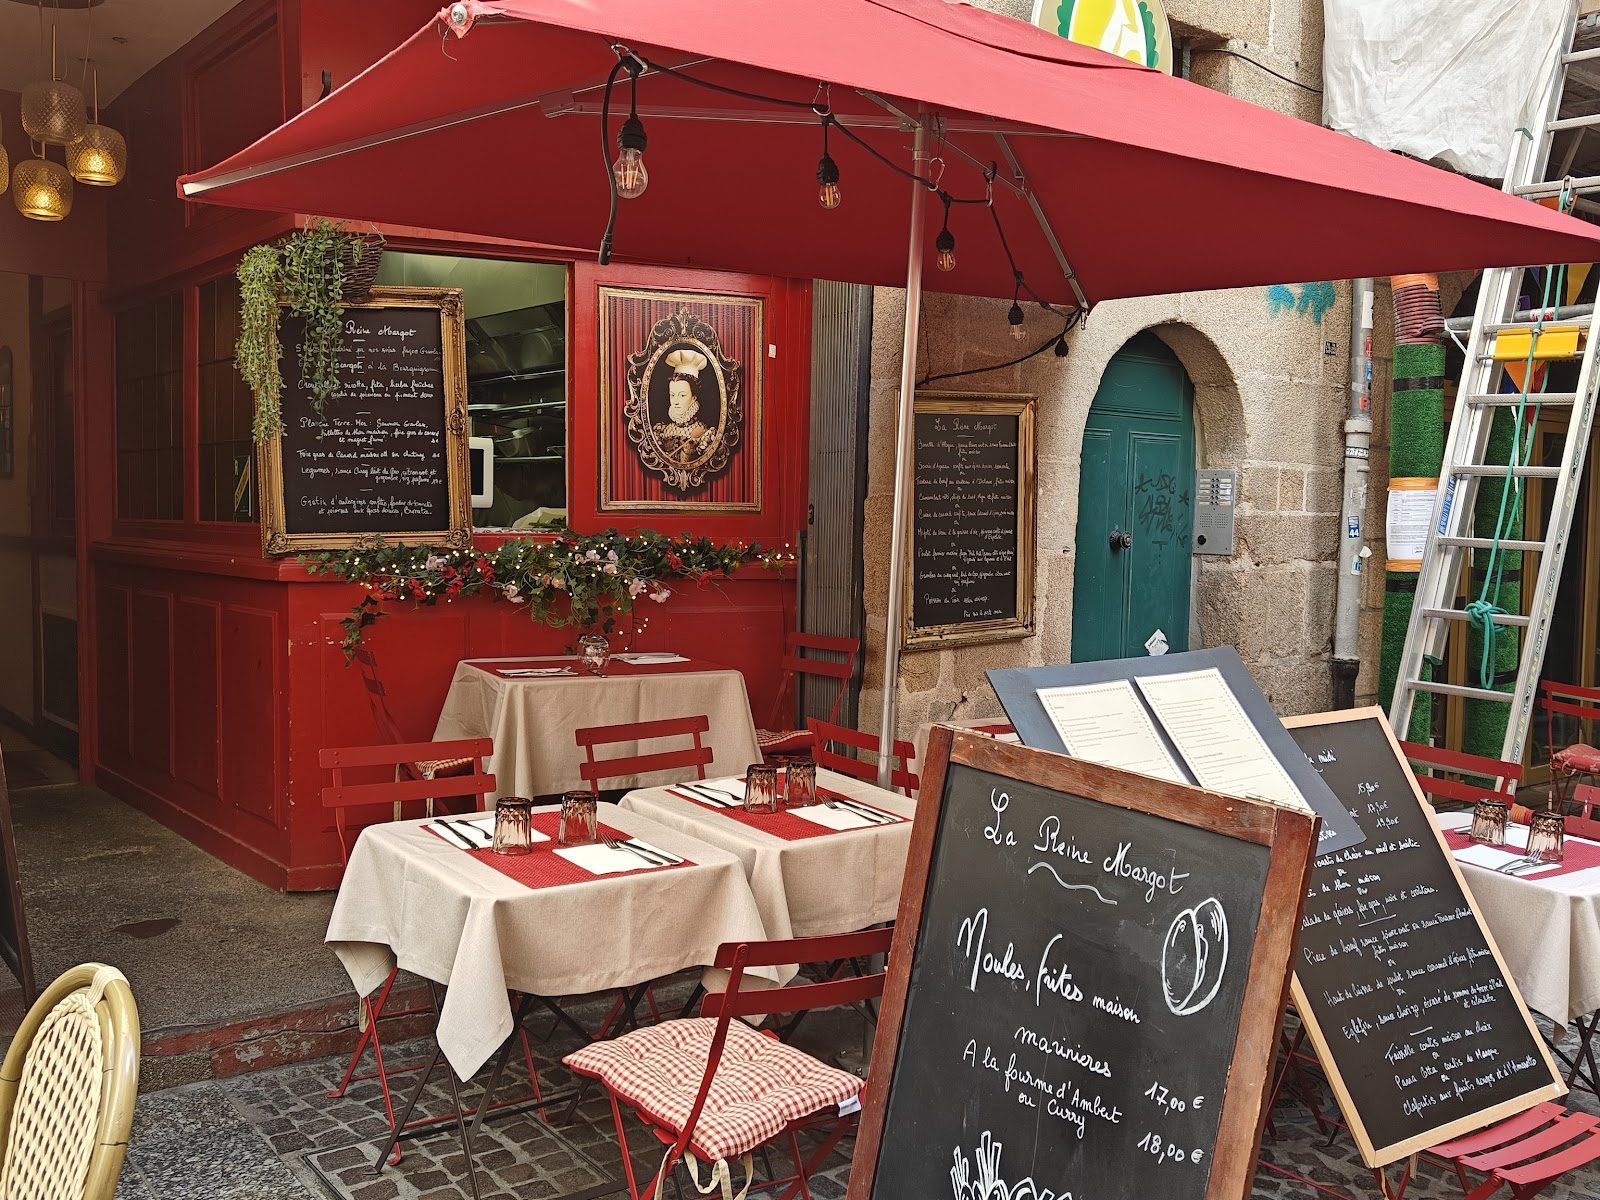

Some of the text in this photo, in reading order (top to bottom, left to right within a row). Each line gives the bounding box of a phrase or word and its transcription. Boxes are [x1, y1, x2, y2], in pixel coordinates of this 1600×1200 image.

[345, 320, 416, 341] Reine Margot
[378, 362, 387, 370] la
[934, 417, 947, 431] La
[296, 449, 311, 458] Foie
[313, 452, 325, 460] gras
[300, 496, 327, 506] Gratin
[984, 788, 1190, 903] La Reine Margot
[957, 908, 1140, 1024] Moules, frites maison
[1420, 1037, 1439, 1050] coulis
[1442, 1031, 1462, 1043] maison
[963, 1039, 1123, 1124] A la fourme d'Ambert
[1144, 1081, 1186, 1116] 17,00
[1193, 1095, 1204, 1109] €
[1018, 1092, 1085, 1139] ou Curry
[1137, 1131, 1205, 1165] 18,00 €
